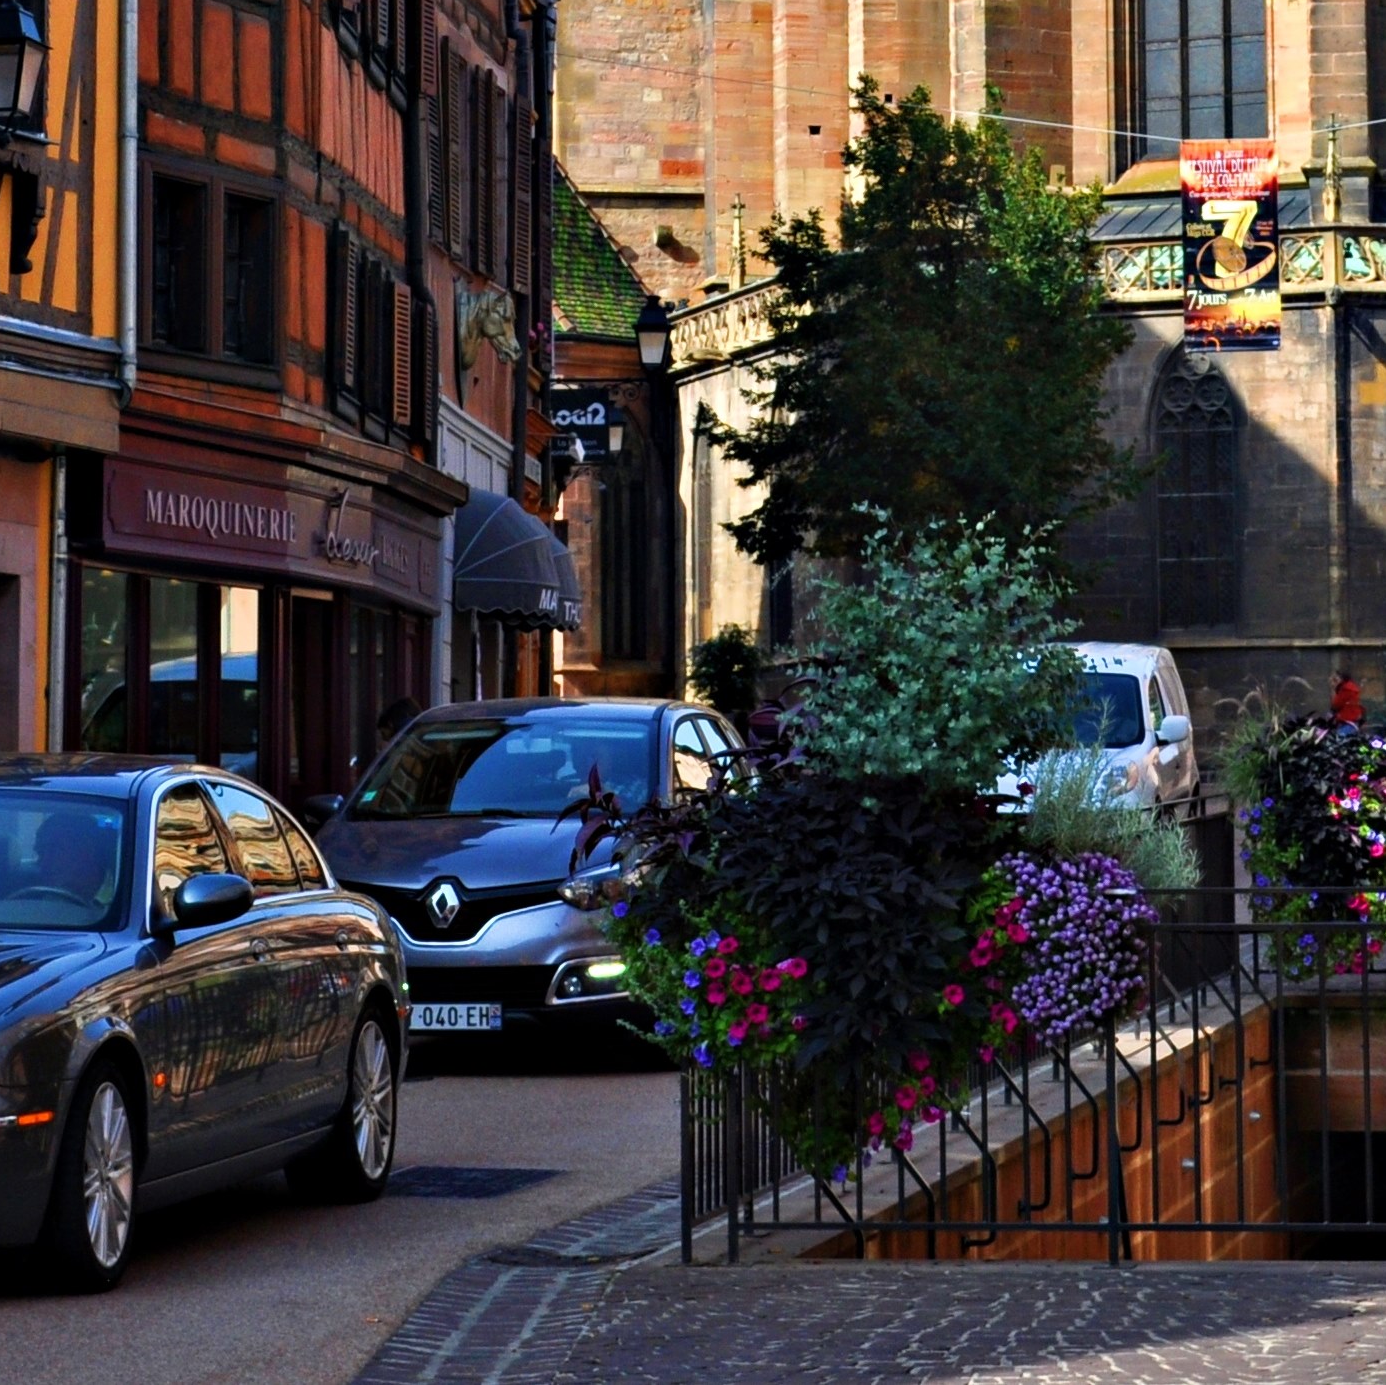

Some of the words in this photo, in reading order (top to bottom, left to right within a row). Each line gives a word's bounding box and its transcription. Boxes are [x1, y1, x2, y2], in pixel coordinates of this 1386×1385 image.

[1188, 159, 1230, 173] FESTIVAL
[1231, 159, 1244, 173] DU
[1202, 174, 1215, 188] DE
[1186, 290, 1198, 310] 7
[1196, 290, 1227, 310] jours
[146, 489, 297, 543] MAROQUINERIE
